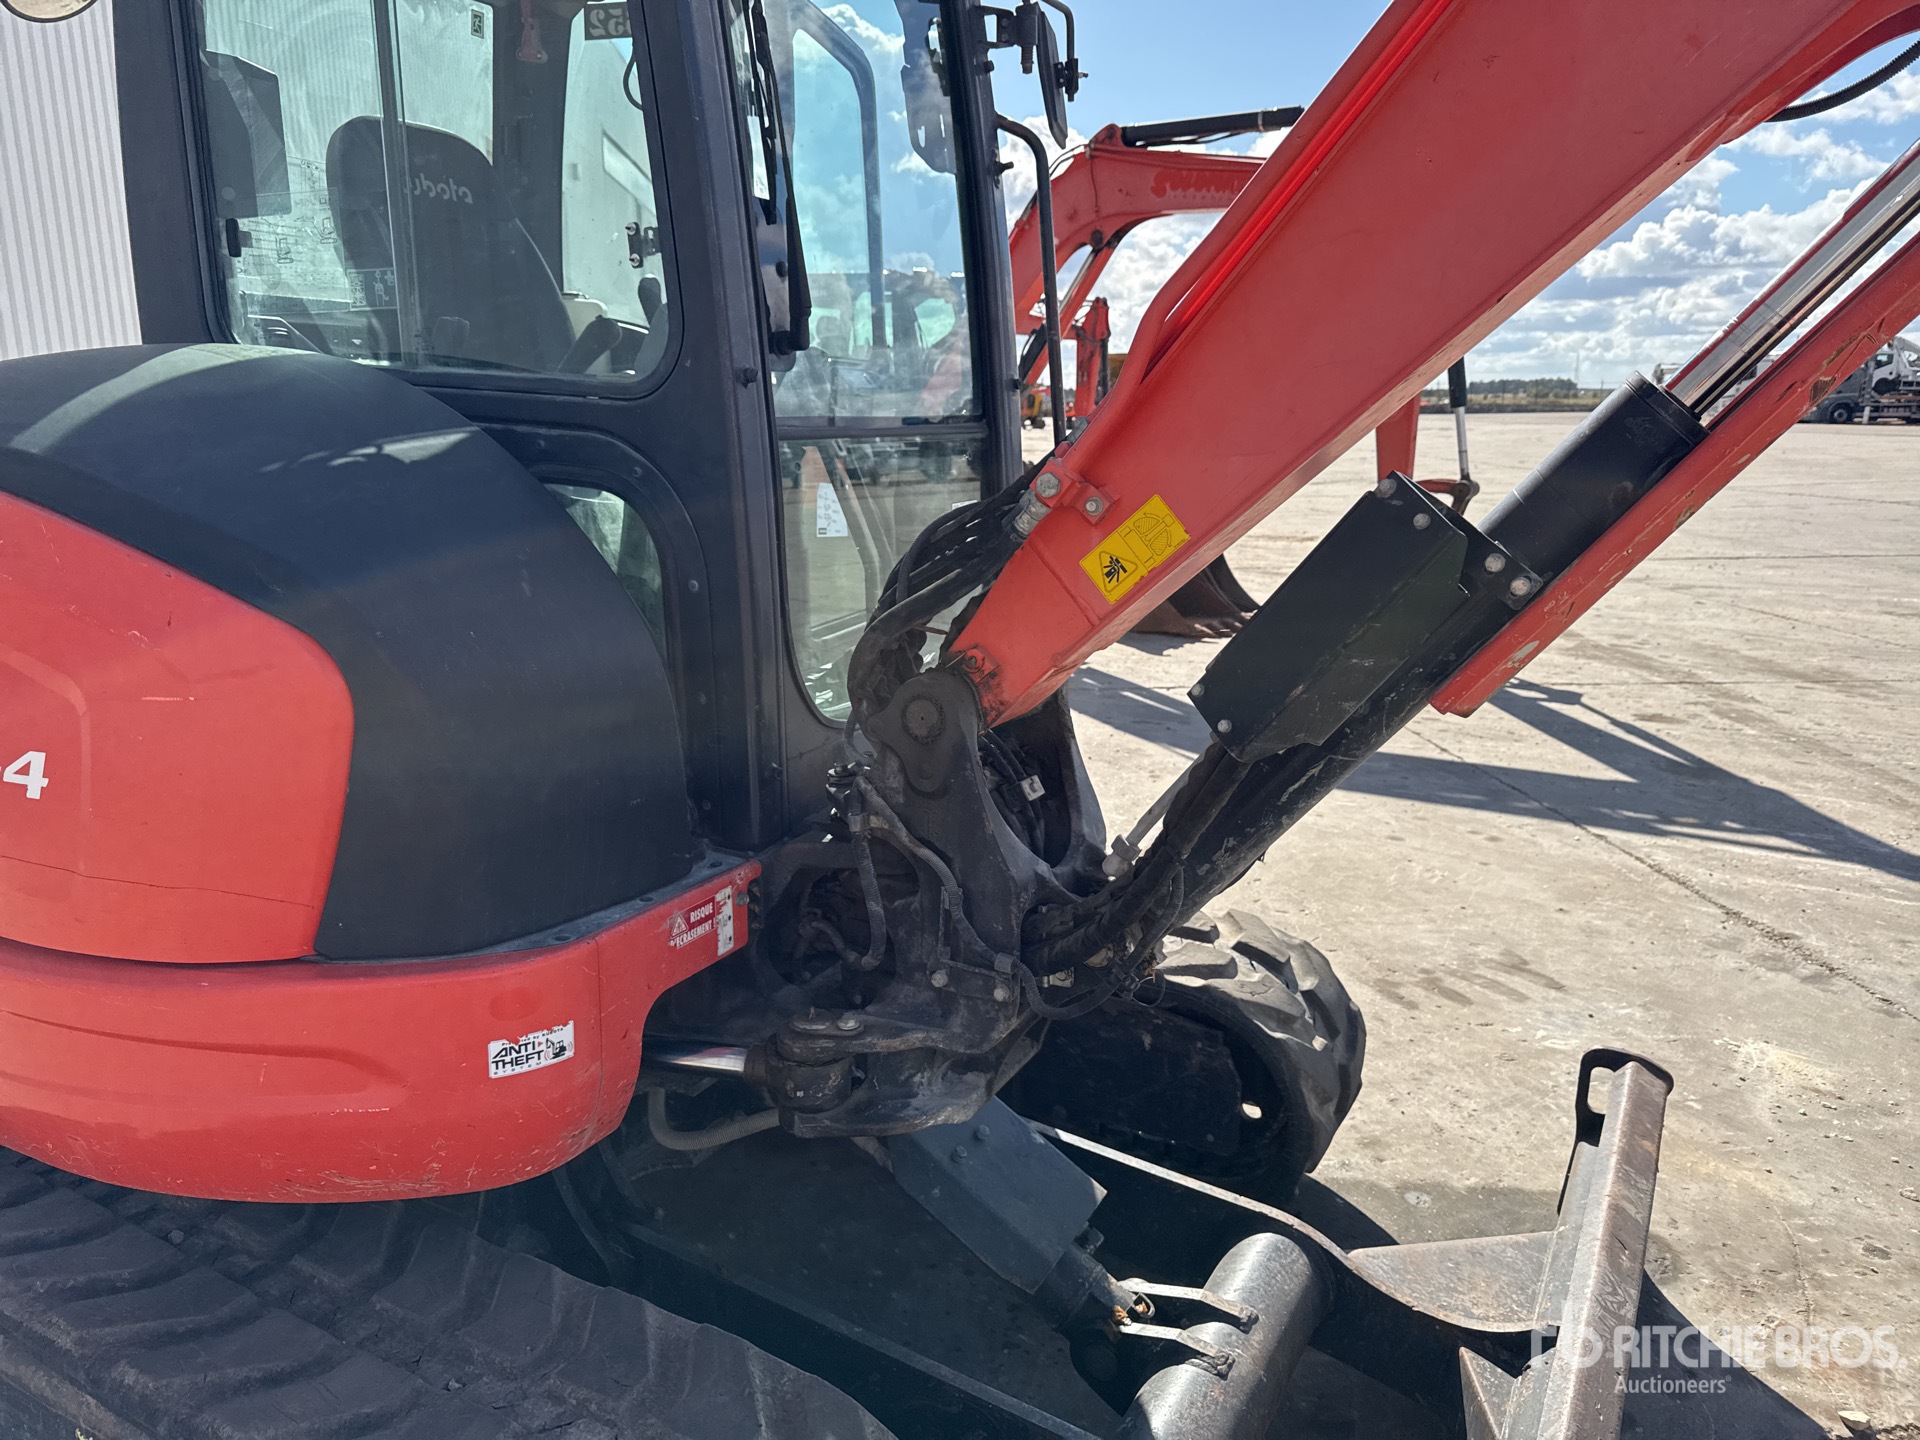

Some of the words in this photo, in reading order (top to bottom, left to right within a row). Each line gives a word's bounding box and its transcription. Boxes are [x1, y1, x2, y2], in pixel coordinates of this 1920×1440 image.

[402, 172, 474, 205] ubota
[0, 750, 49, 800] 4
[690, 902, 713, 924] RISQUE
[491, 1041, 536, 1060] ANTI
[491, 1050, 545, 1070] THEFT
